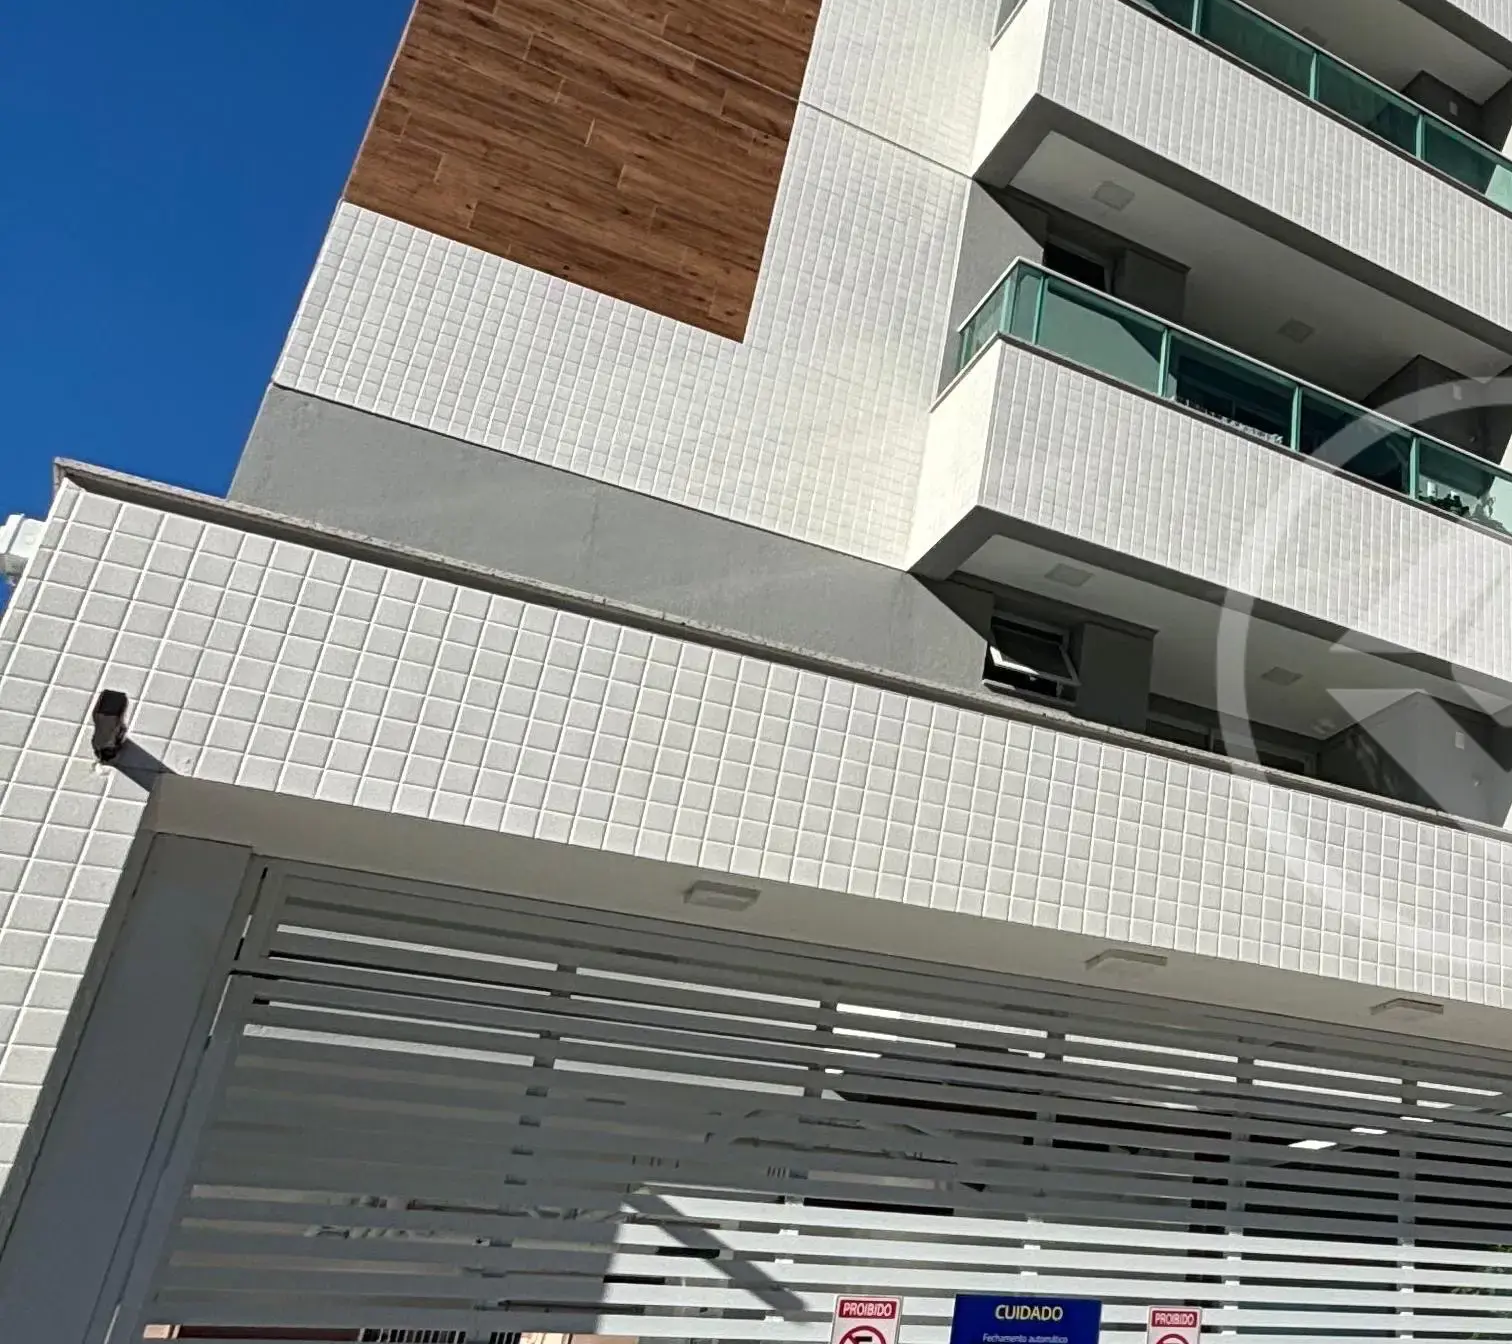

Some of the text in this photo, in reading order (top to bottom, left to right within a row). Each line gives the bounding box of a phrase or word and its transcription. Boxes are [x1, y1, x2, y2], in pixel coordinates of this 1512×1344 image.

[842, 1302, 893, 1318] PROIBIDO
[995, 1304, 1064, 1321] CUIDADO
[1154, 1312, 1195, 1326] PROIBIDO
[982, 1332, 1027, 1343] Fechamento
